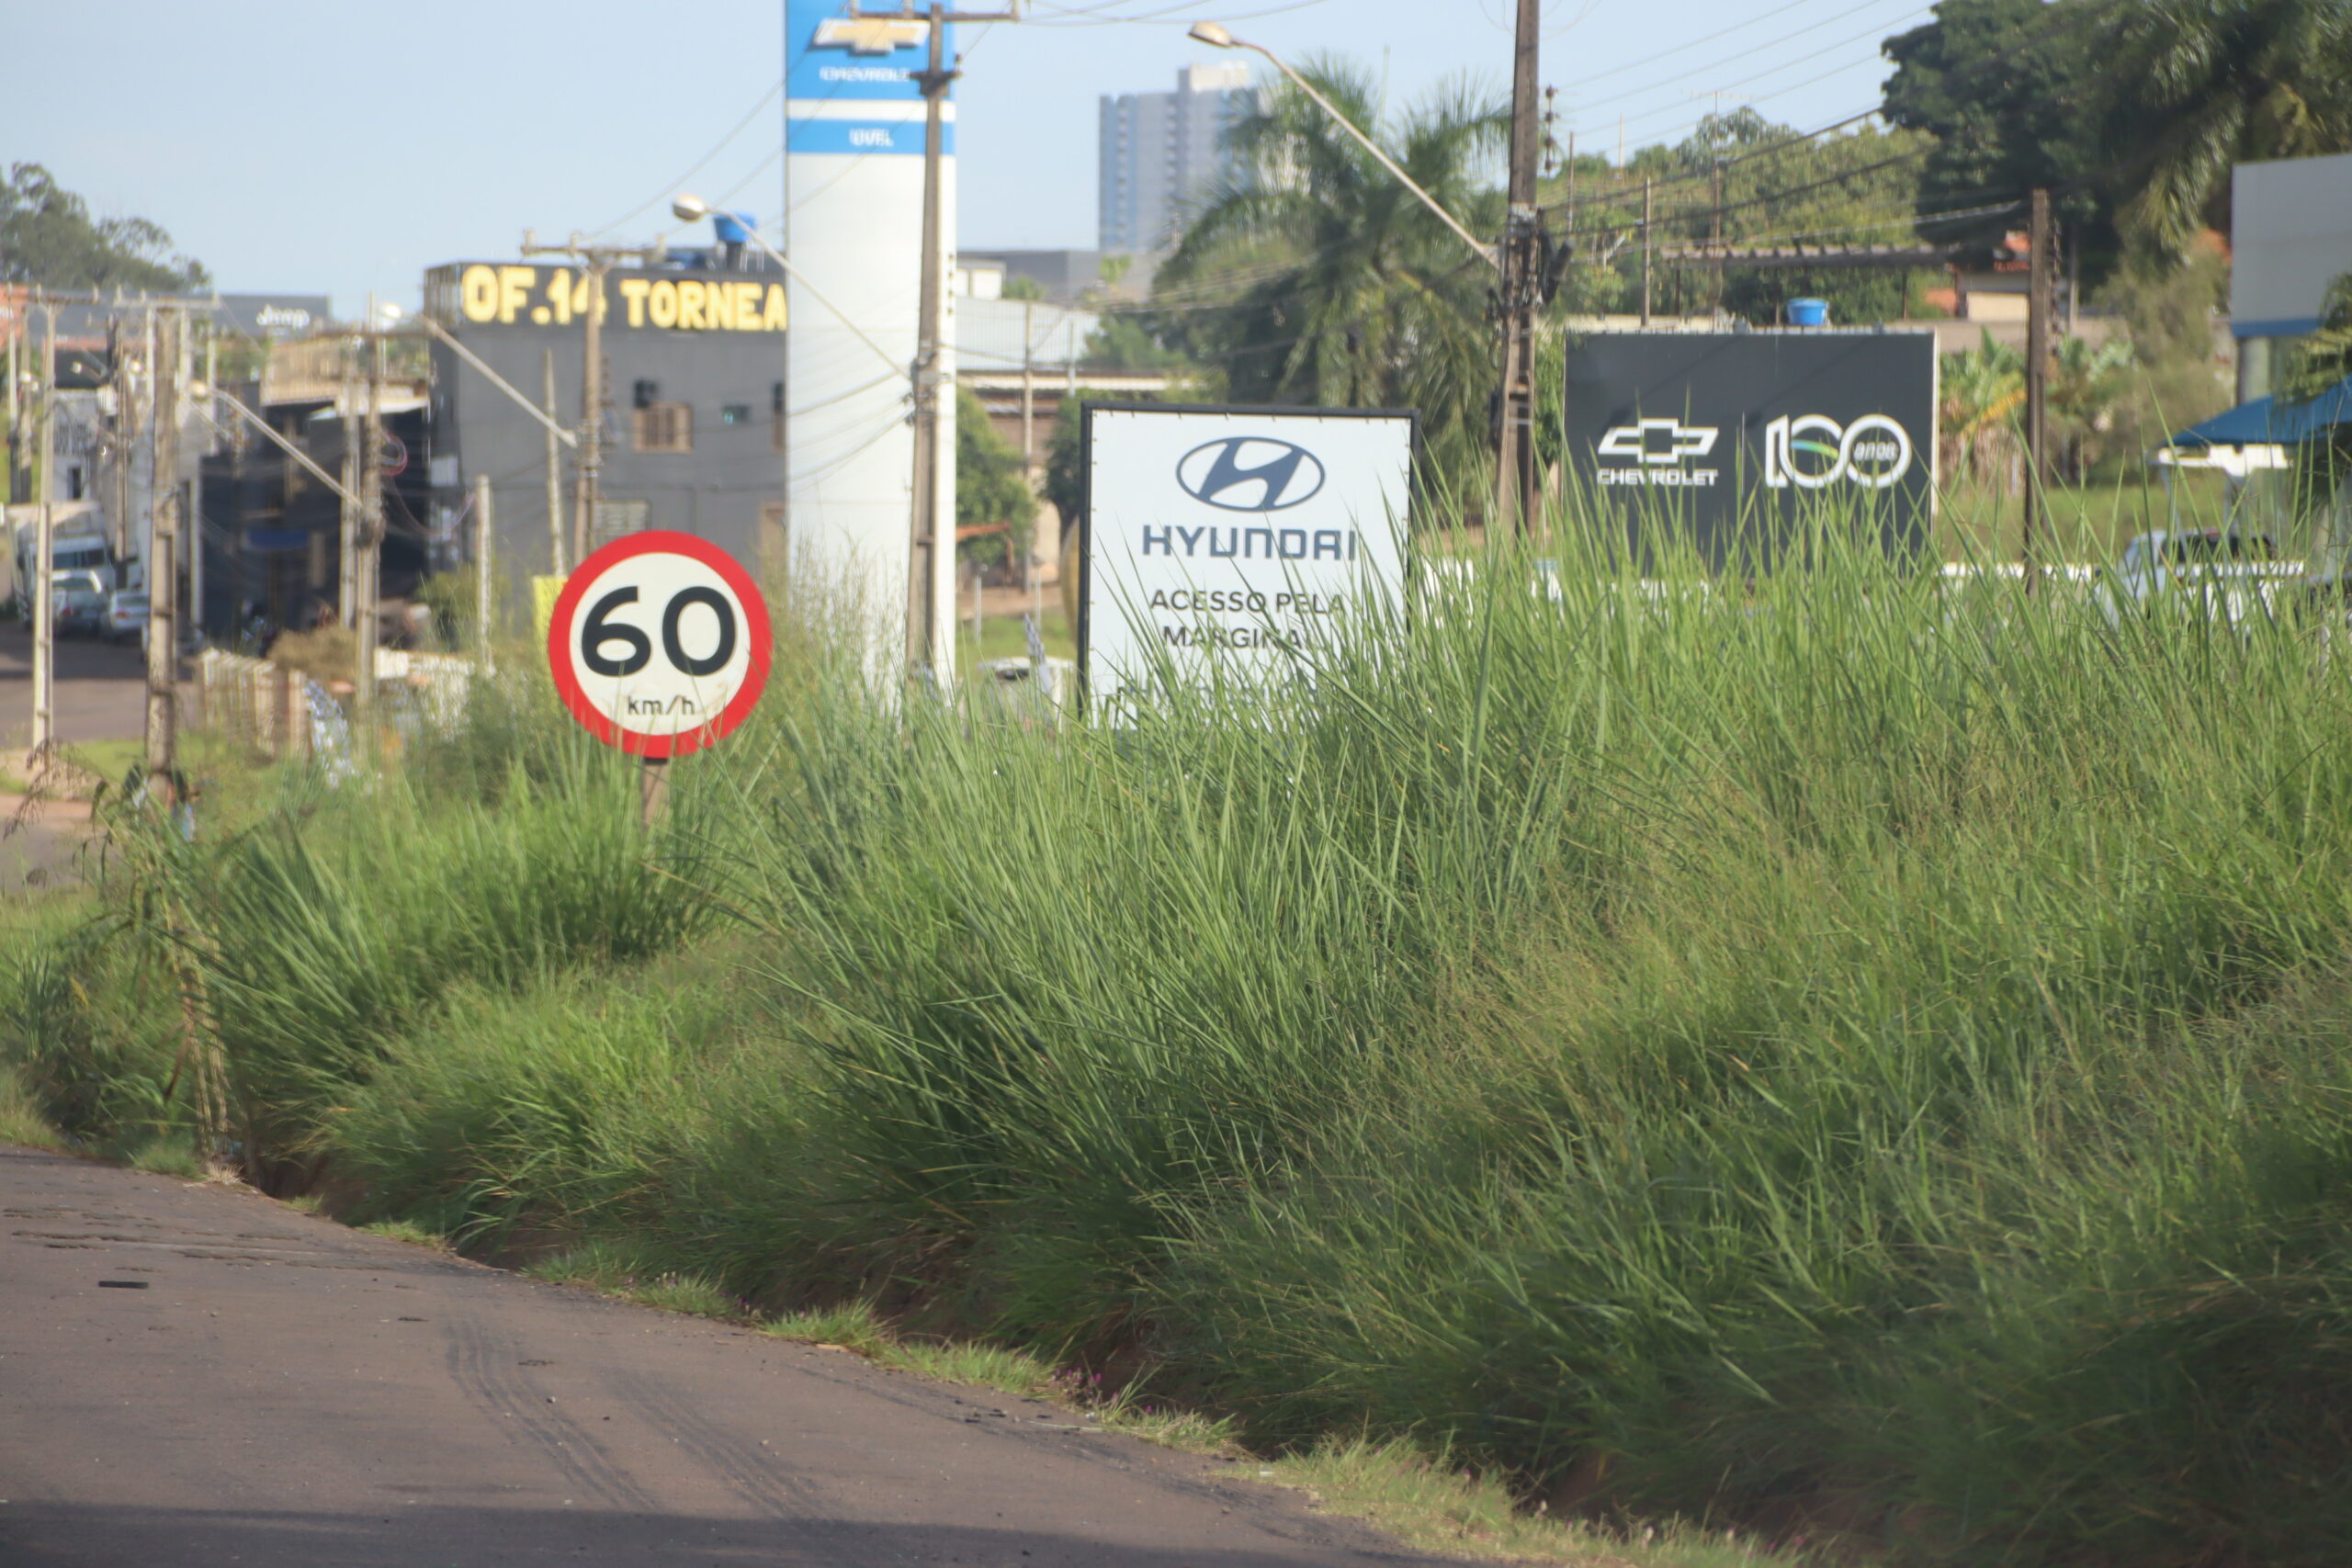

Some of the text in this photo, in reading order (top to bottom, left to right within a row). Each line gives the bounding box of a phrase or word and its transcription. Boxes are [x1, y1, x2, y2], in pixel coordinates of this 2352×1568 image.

[619, 278, 786, 332] TORNEA
[1765, 413, 1912, 489] 100
[1597, 468, 1718, 486] CHEVROLET
[1142, 525, 1356, 562] HYUNDAI
[1150, 589, 1346, 615] ACESSO PELA
[582, 585, 736, 678] 60
[1162, 626, 1305, 650] MARGINA
[628, 696, 695, 716] km/h
